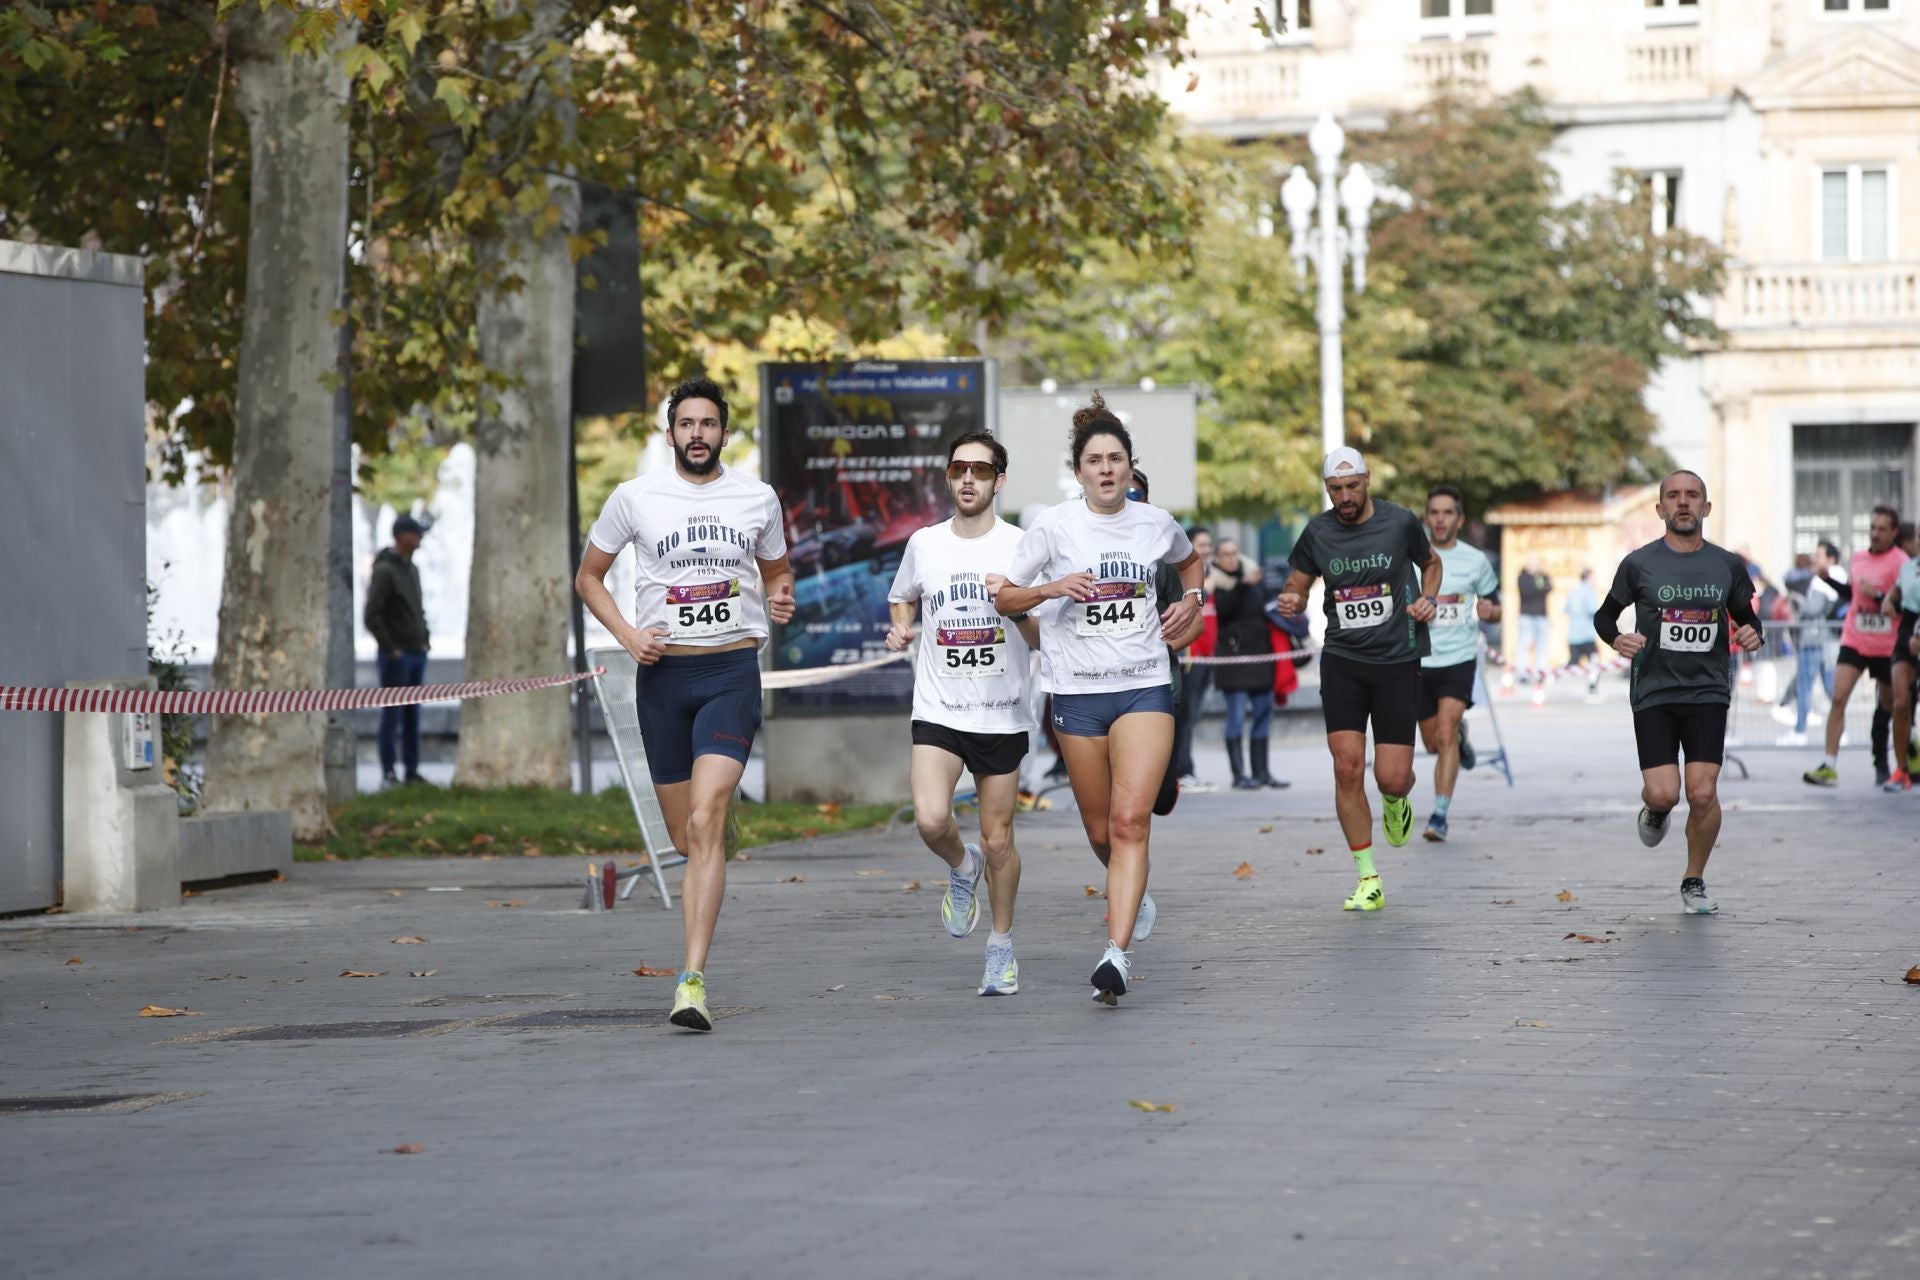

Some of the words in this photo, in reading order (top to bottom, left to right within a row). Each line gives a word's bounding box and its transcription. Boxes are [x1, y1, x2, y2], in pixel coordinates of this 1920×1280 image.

[801, 377, 876, 392] Aytamiento
[894, 376, 948, 389] Valladolid
[687, 515, 721, 525] HOSPITAL
[657, 531, 680, 559] RIO
[670, 558, 741, 569] UNIVERSITARIO
[1100, 551, 1132, 561] HOSPITAL
[697, 568, 716, 577] 1953
[950, 572, 981, 583] HOSPITAL
[678, 601, 731, 627] 546
[1086, 600, 1136, 626] 544
[1344, 600, 1385, 620] 899
[938, 616, 1001, 628] UNIVERSITARIO
[1669, 625, 1711, 643] 900
[946, 646, 996, 668] 545
